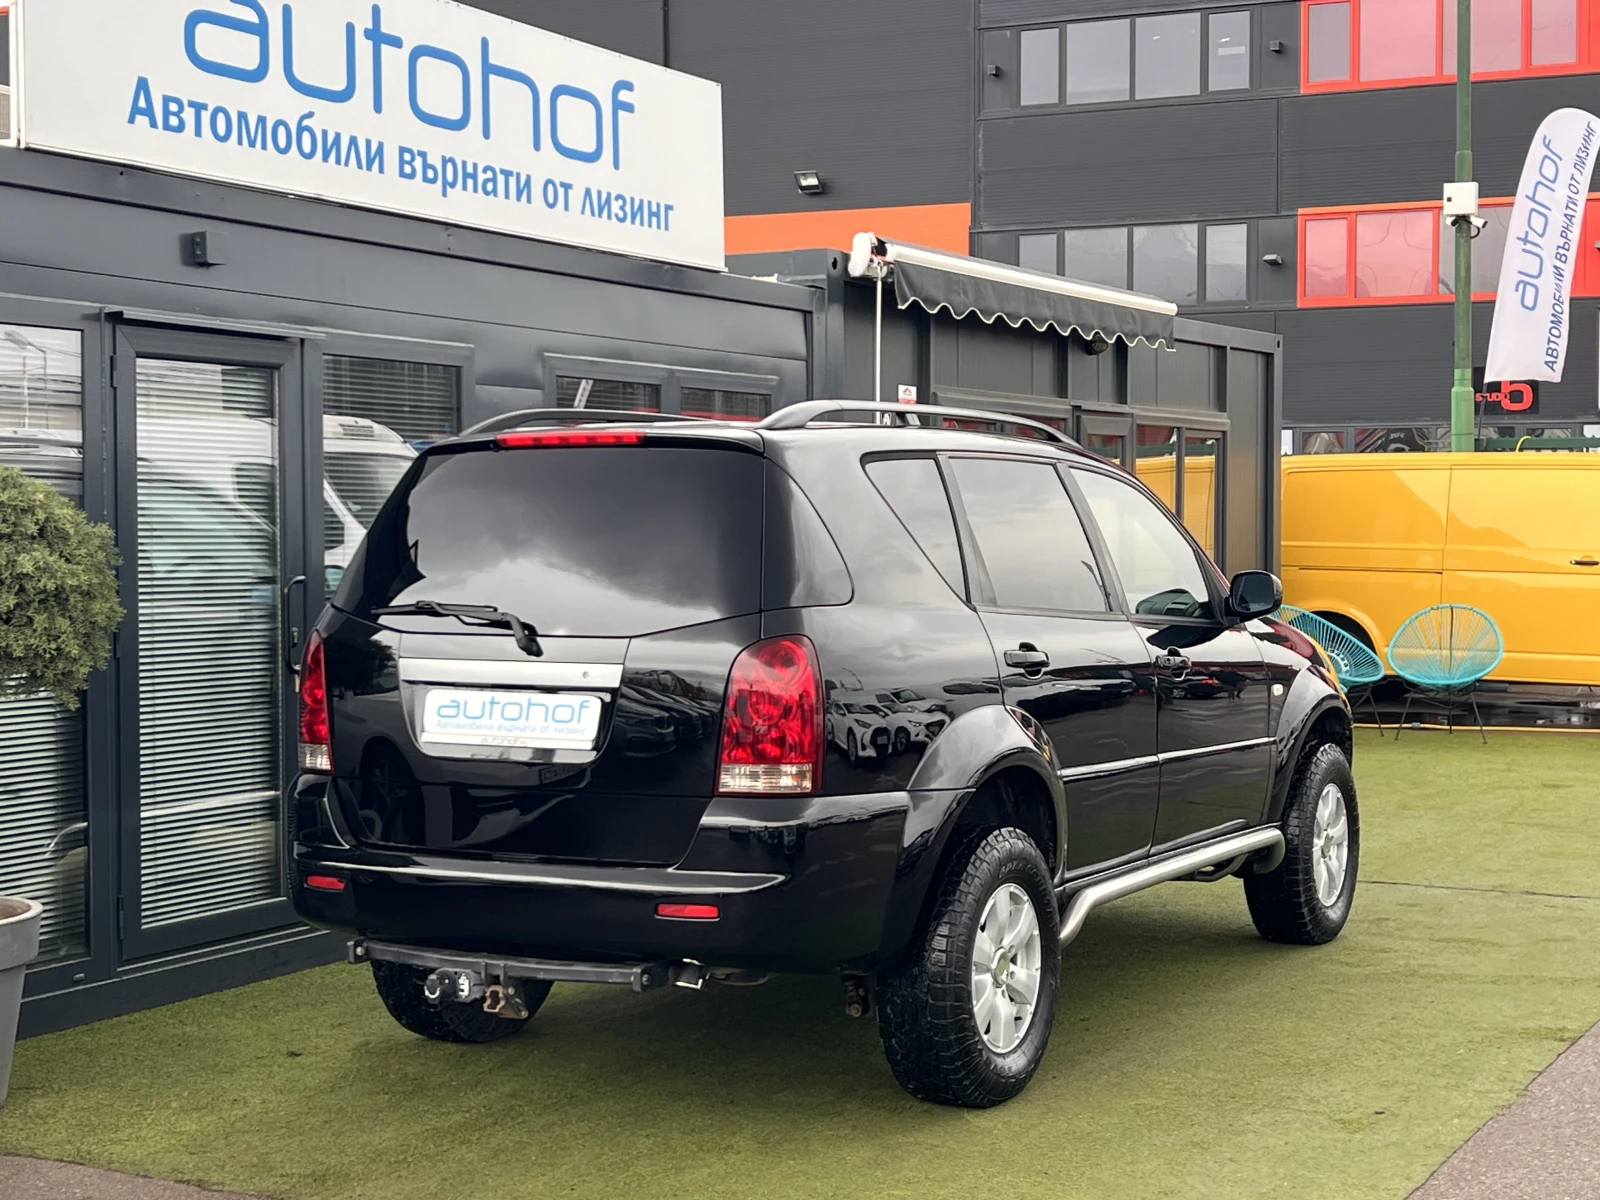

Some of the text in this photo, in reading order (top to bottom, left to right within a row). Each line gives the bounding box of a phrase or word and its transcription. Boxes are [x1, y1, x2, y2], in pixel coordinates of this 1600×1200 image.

[183, 0, 635, 170] autohof
[127, 76, 674, 231] Автомобили върнати от лизинг
[1573, 121, 1596, 177] ЛИЗИНГ
[1567, 173, 1581, 195] ОТ
[1514, 134, 1562, 311] autohof
[1554, 195, 1579, 264] ВЪРНАТИ
[436, 696, 590, 724] autohof
